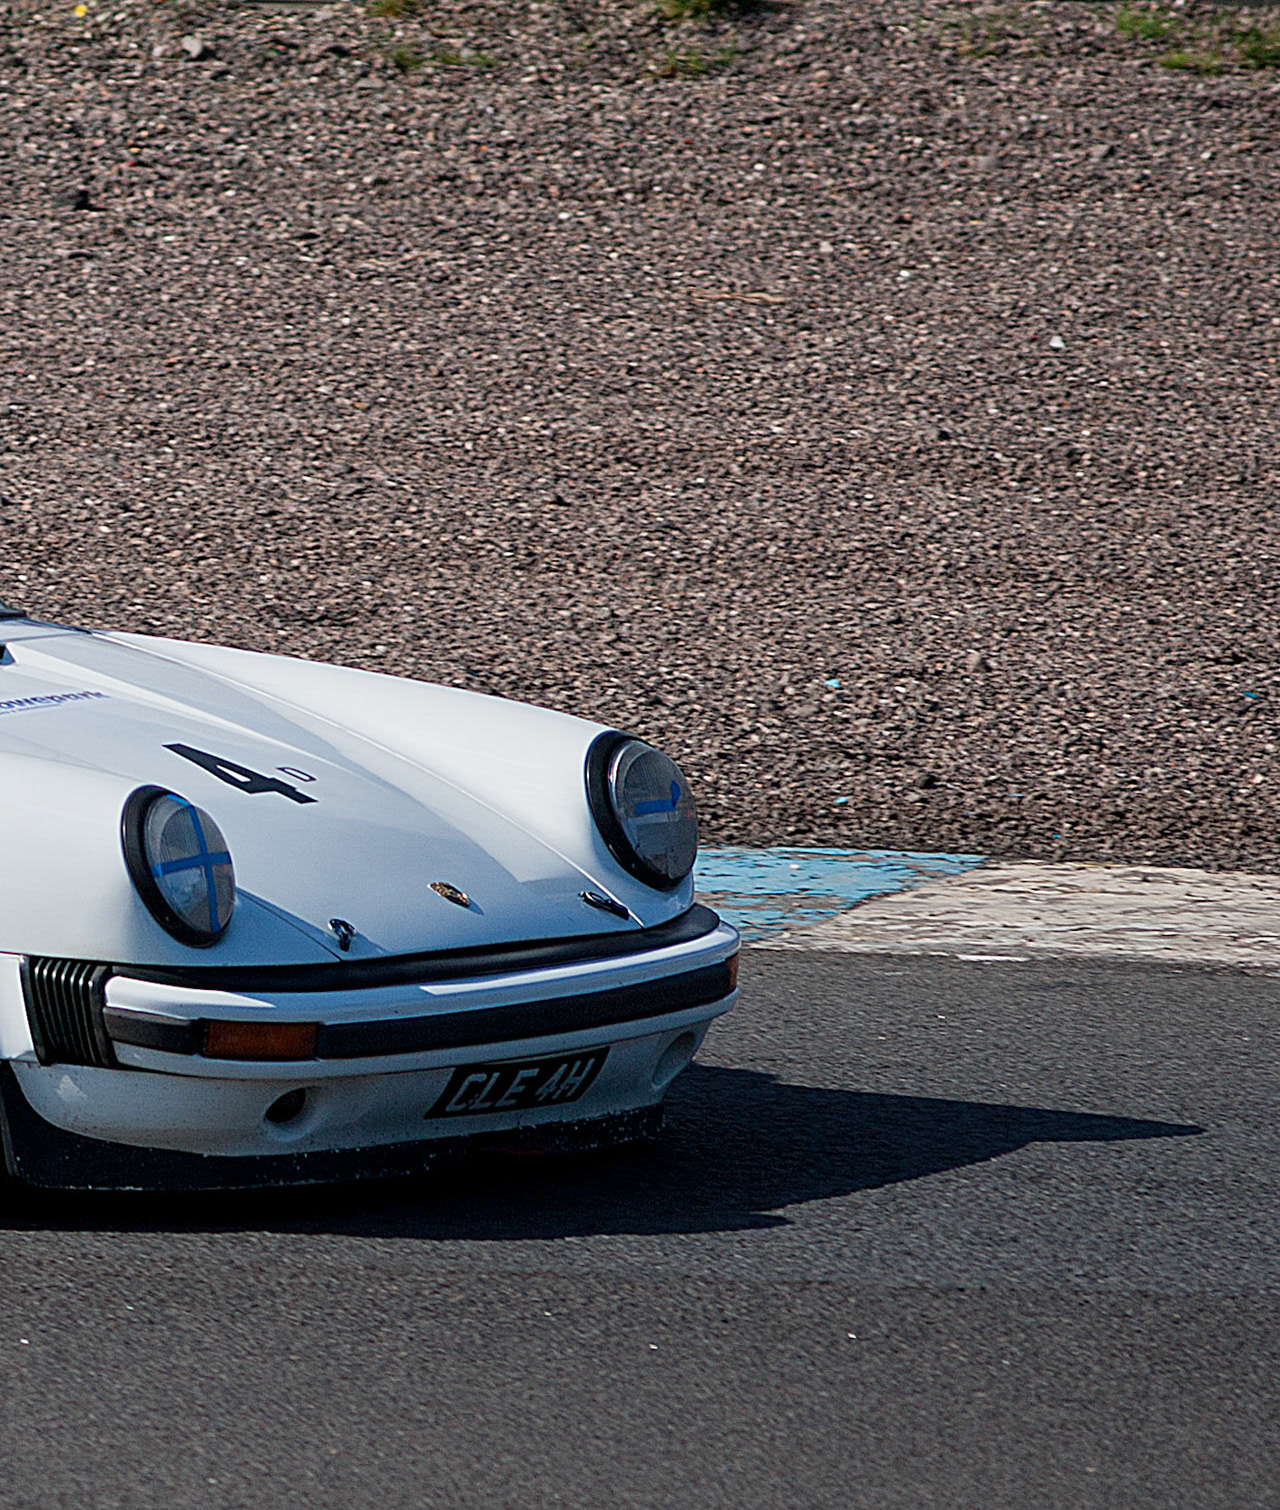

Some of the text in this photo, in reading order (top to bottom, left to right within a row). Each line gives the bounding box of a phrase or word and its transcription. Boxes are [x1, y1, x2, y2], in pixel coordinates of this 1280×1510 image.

[162, 743, 319, 804] 4 D
[445, 1057, 595, 1112] CLE 4H
